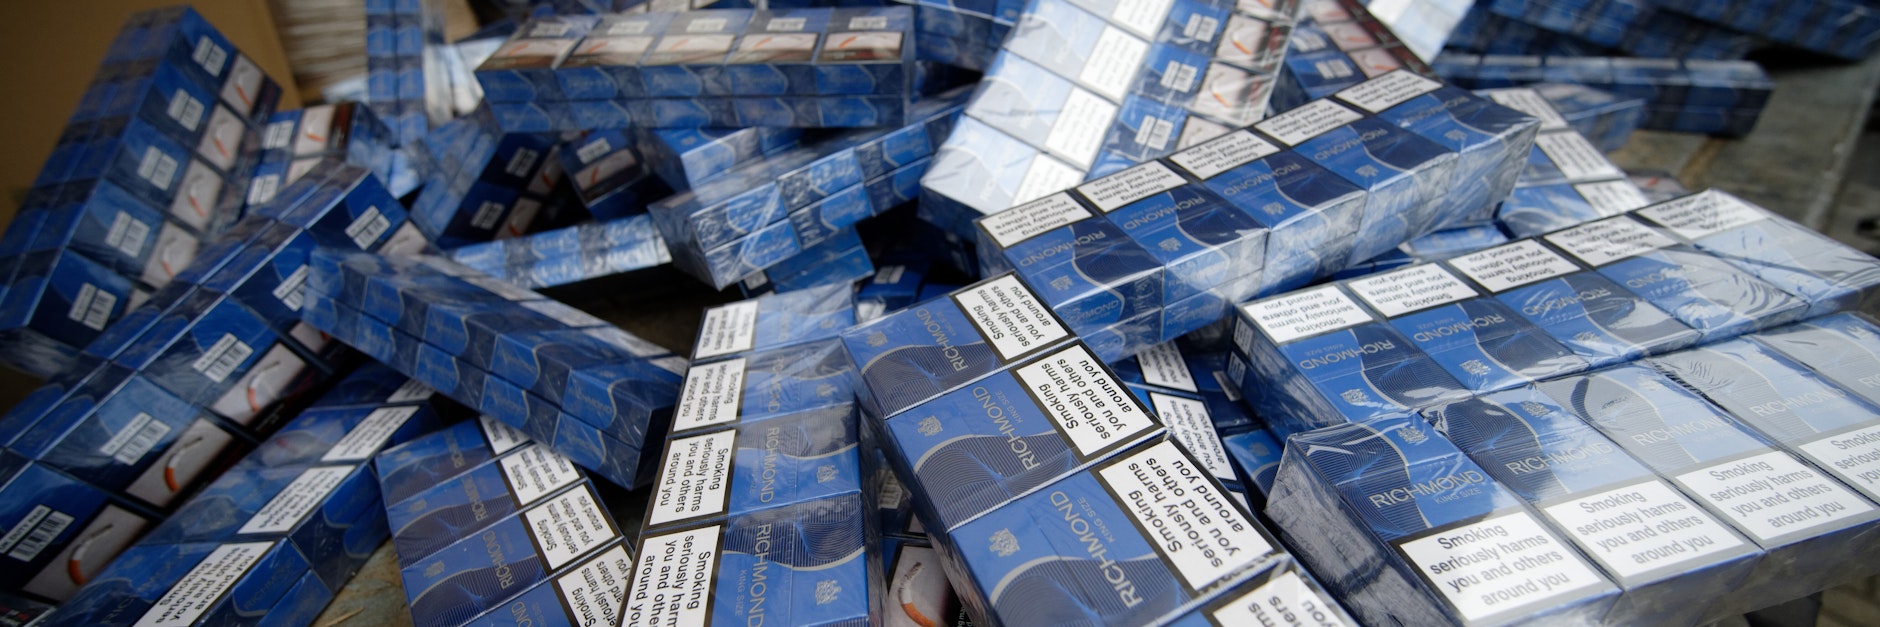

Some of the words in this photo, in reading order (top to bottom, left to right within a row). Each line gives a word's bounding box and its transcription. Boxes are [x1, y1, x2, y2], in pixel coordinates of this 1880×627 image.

[1019, 230, 1106, 266] RICHMOND
[978, 289, 1000, 313] harms
[991, 286, 1014, 308] others
[1010, 286, 1028, 300] you
[1264, 300, 1282, 310] you
[1284, 292, 1324, 306] around
[1323, 297, 1344, 306] you
[974, 305, 1004, 340] Smoking
[1010, 308, 1028, 324] and
[1021, 300, 1050, 326] around
[1262, 309, 1298, 321] others
[1268, 316, 1304, 330] harms
[1300, 304, 1321, 314] and
[1305, 304, 1354, 322] seriously
[916, 308, 968, 372] RICHMOND
[996, 311, 1030, 347] seriously
[1026, 324, 1045, 340] you
[1294, 318, 1346, 334] Smoking
[1414, 313, 1506, 342] RICHMOND
[1079, 360, 1101, 378] you
[1300, 340, 1396, 370] RICHMOND
[1041, 364, 1068, 392] harms
[1057, 359, 1086, 388] others
[1038, 384, 1079, 430] Smoking
[1087, 389, 1106, 408] and
[1095, 378, 1132, 414] around
[972, 386, 1041, 471] RICHMOND
[1067, 389, 1110, 440] seriously
[1102, 409, 1127, 431] you
[1631, 416, 1733, 447] RICHMOND
[1830, 430, 1880, 450] Smokin
[689, 441, 699, 457] you
[696, 438, 714, 477] seriously
[1505, 442, 1614, 476] RICHMOND
[666, 452, 680, 486] around
[684, 460, 694, 477] and
[709, 448, 728, 490] Smoking
[760, 427, 780, 503] RICHMOND
[1146, 458, 1185, 497] others
[1172, 460, 1200, 484] you
[1709, 460, 1774, 482] Smoking
[660, 487, 672, 506] you
[676, 480, 692, 513] others
[691, 478, 708, 512] harms
[1128, 462, 1166, 504] harms
[1369, 470, 1485, 508] RICHMOND
[1434, 492, 1460, 504] KING
[1460, 488, 1482, 500] SIZE
[1710, 478, 1774, 502] seriously
[1770, 469, 1814, 486] harms
[1078, 496, 1094, 518] SIZE
[1182, 499, 1210, 525] and
[1193, 484, 1244, 532] around
[1580, 491, 1646, 514] Smoking
[1731, 502, 1762, 518] you
[1760, 491, 1790, 508] and
[1788, 482, 1832, 501] others
[1768, 506, 1820, 528] around
[1817, 501, 1846, 517] you
[1092, 518, 1116, 543] KING
[1128, 490, 1182, 552] Smoking
[1576, 510, 1644, 536] seriously
[1638, 500, 1686, 518] harms
[1596, 535, 1628, 552] you
[1627, 524, 1658, 542] and
[1658, 514, 1704, 534] others
[1050, 490, 1144, 608] RICHMOND
[1164, 504, 1222, 567] seriously
[1210, 528, 1240, 556] you
[1437, 524, 1509, 550] Smoking
[1632, 540, 1686, 564] around
[1683, 534, 1714, 552] you
[666, 540, 677, 562] you
[672, 535, 694, 590] seriously
[1430, 546, 1500, 575] seriously
[1498, 534, 1549, 554] harms
[582, 568, 600, 594] harms
[596, 561, 615, 586] others
[636, 555, 655, 600] around
[657, 566, 671, 590] and
[686, 552, 711, 610] Smoking
[748, 524, 772, 627] RICHMOND
[1448, 573, 1480, 593] you
[1480, 563, 1513, 582] and
[1514, 550, 1564, 572] others
[608, 586, 623, 603] and
[1480, 578, 1540, 605] around
[1537, 572, 1571, 591] you
[572, 588, 597, 627] Smoking
[594, 592, 617, 626] eriously
[650, 594, 666, 627] othe
[667, 594, 685, 627] harm
